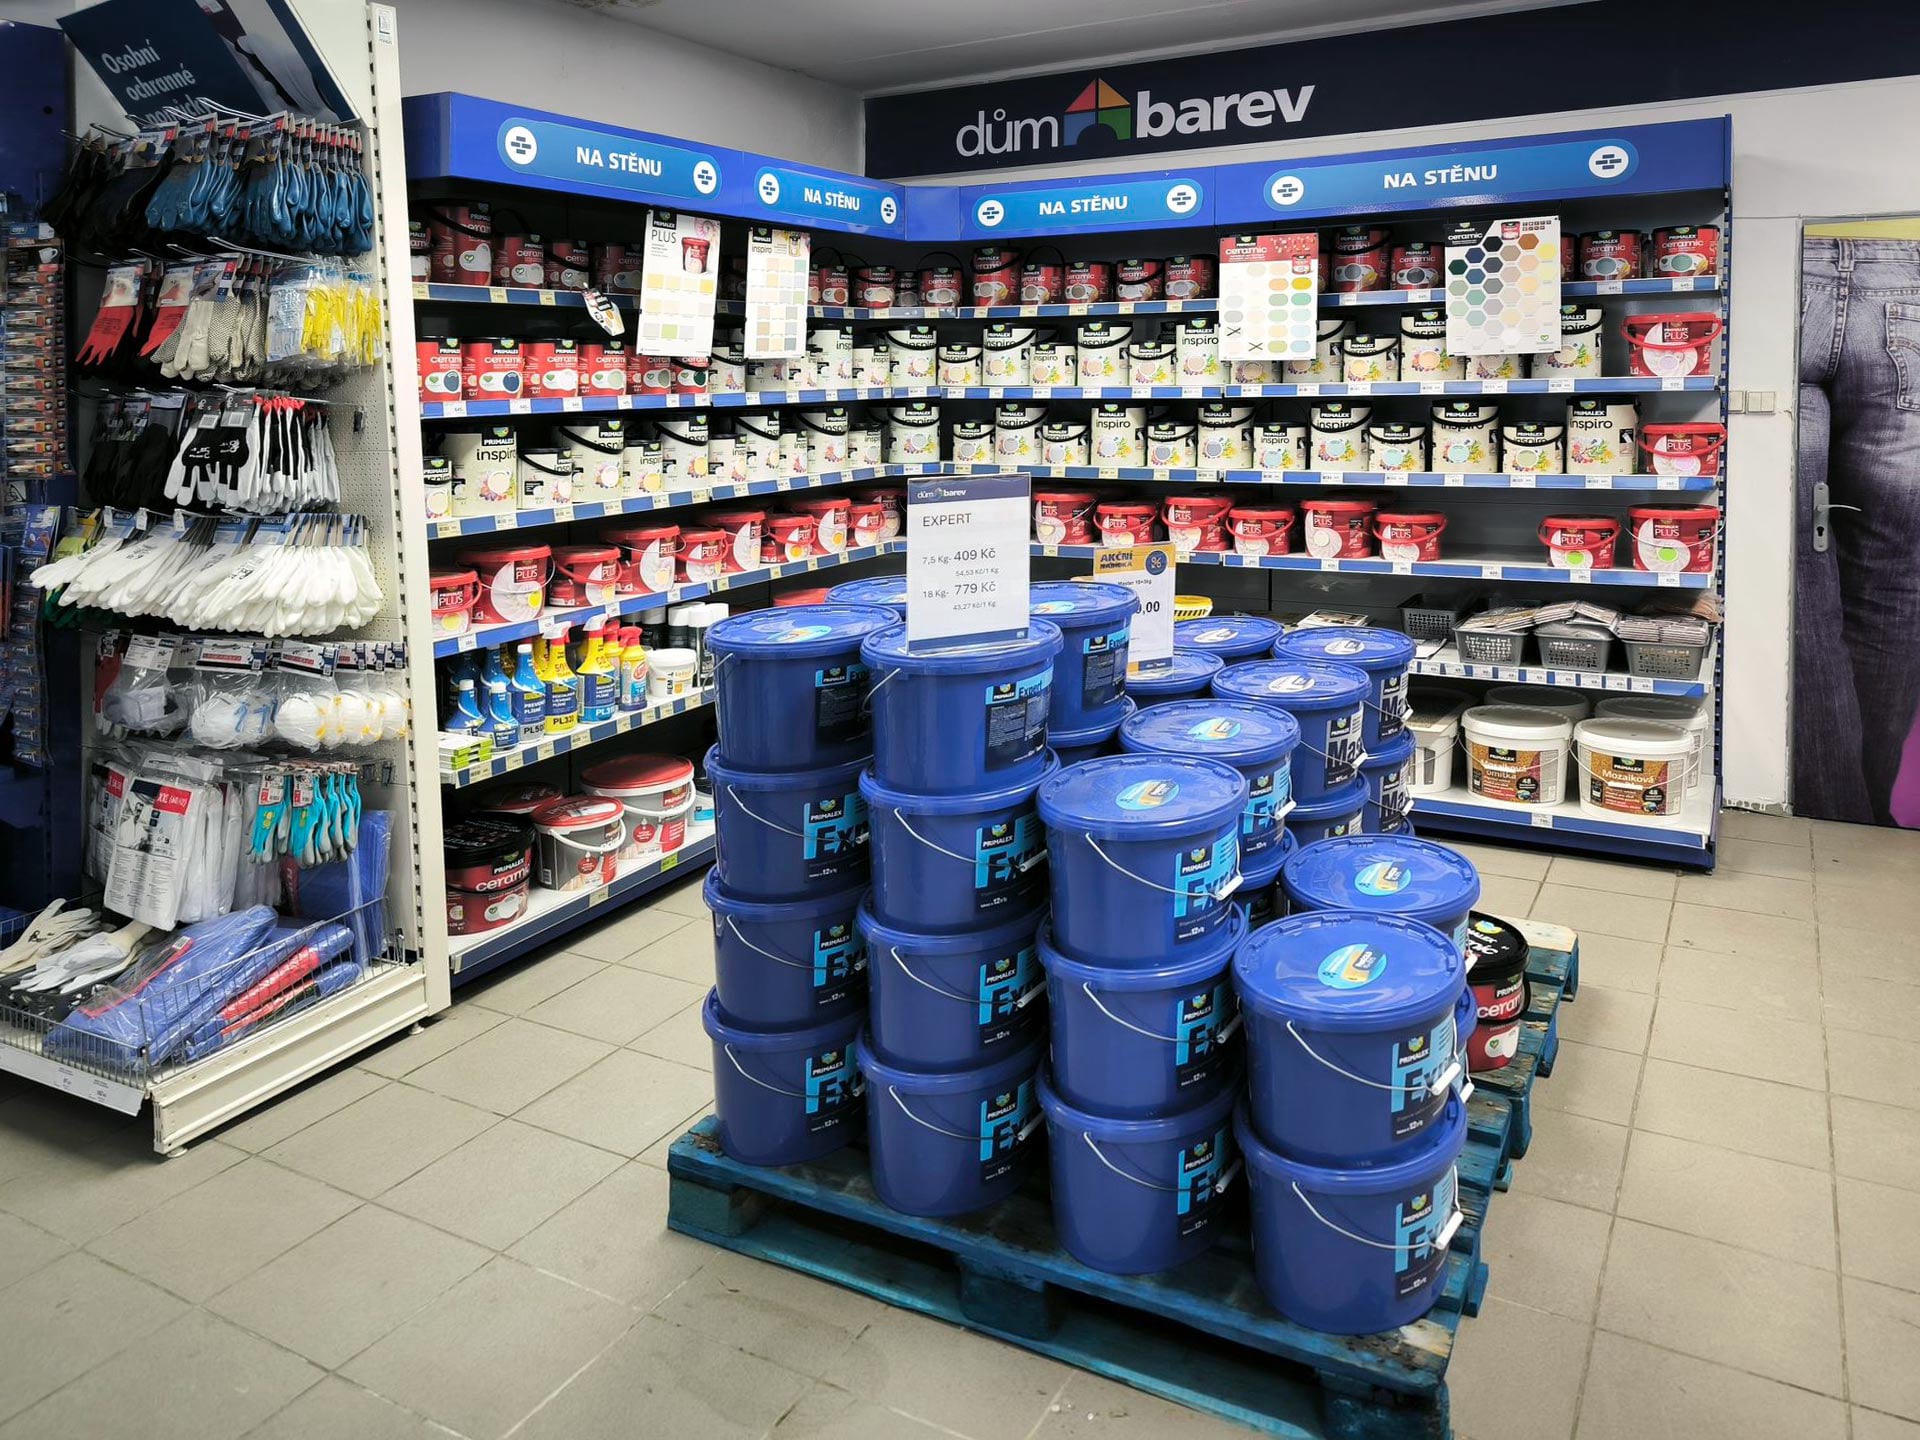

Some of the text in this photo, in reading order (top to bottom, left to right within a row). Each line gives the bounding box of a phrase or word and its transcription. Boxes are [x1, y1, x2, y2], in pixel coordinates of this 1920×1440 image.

[102, 38, 161, 74] Osobní
[126, 62, 196, 101] ochranné
[956, 84, 1316, 157] dům barev
[576, 145, 663, 178] NA STĚNU
[1383, 163, 1498, 190] NA STĚNU
[803, 187, 861, 212] NA STĚNU
[1038, 194, 1129, 216] NA STĚNU
[651, 229, 677, 245] PLUS
[1448, 231, 1483, 240] ceramic
[1586, 244, 1626, 253] ceramic
[1661, 239, 1704, 248] ceramic
[1225, 246, 1268, 255] ceramic
[1399, 255, 1437, 263] ceramic
[1066, 272, 1095, 281] ceramic
[1167, 268, 1196, 277] ceramic
[1562, 313, 1585, 321] MALEX
[1181, 336, 1219, 347] inspiro
[1664, 331, 1689, 340] PLUS
[1095, 419, 1131, 431] inspiro
[1569, 418, 1613, 432] inspiro
[1260, 437, 1290, 447] inspiro
[1667, 442, 1692, 451] PLUS
[943, 487, 967, 497] barev
[1042, 509, 1058, 517] PLUS
[1175, 513, 1191, 521] PLUS
[922, 512, 972, 528] EXPERT
[1109, 520, 1127, 529] PLUS
[1313, 518, 1333, 527] PLUS
[1243, 526, 1262, 535] PLUS
[1391, 531, 1411, 539] PLUS
[1654, 529, 1680, 538] PLUS
[1561, 537, 1584, 546] PLUS
[922, 556, 936, 566] 7,5
[953, 549, 978, 562] 409
[980, 547, 997, 560] Kč
[1100, 549, 1133, 562] AKČNÍ
[515, 568, 538, 581] PLUS
[922, 590, 934, 599] 18
[954, 582, 978, 596] 779
[980, 581, 997, 594] Kč
[438, 595, 463, 606] PLUS
[1602, 768, 1655, 785] Mozaiková
[1250, 785, 1273, 797] PRIMALEX
[810, 810, 842, 822] PRIMALEX
[982, 835, 1014, 848] PRIMALEX
[493, 857, 525, 875] PRIMALEX
[1181, 859, 1211, 875] PRIMALEX
[820, 934, 850, 949] PRIMALEX
[986, 968, 1016, 984] PRIMALEX
[1184, 1006, 1212, 1021] PRIMALEX
[1399, 1049, 1430, 1066] PRIMALEX
[812, 1060, 843, 1077] PRIMALEX
[987, 1103, 1016, 1120] PRIMALEX
[1185, 1153, 1213, 1171] PRIMALEX
[1402, 1206, 1432, 1225] PRIMALEX
